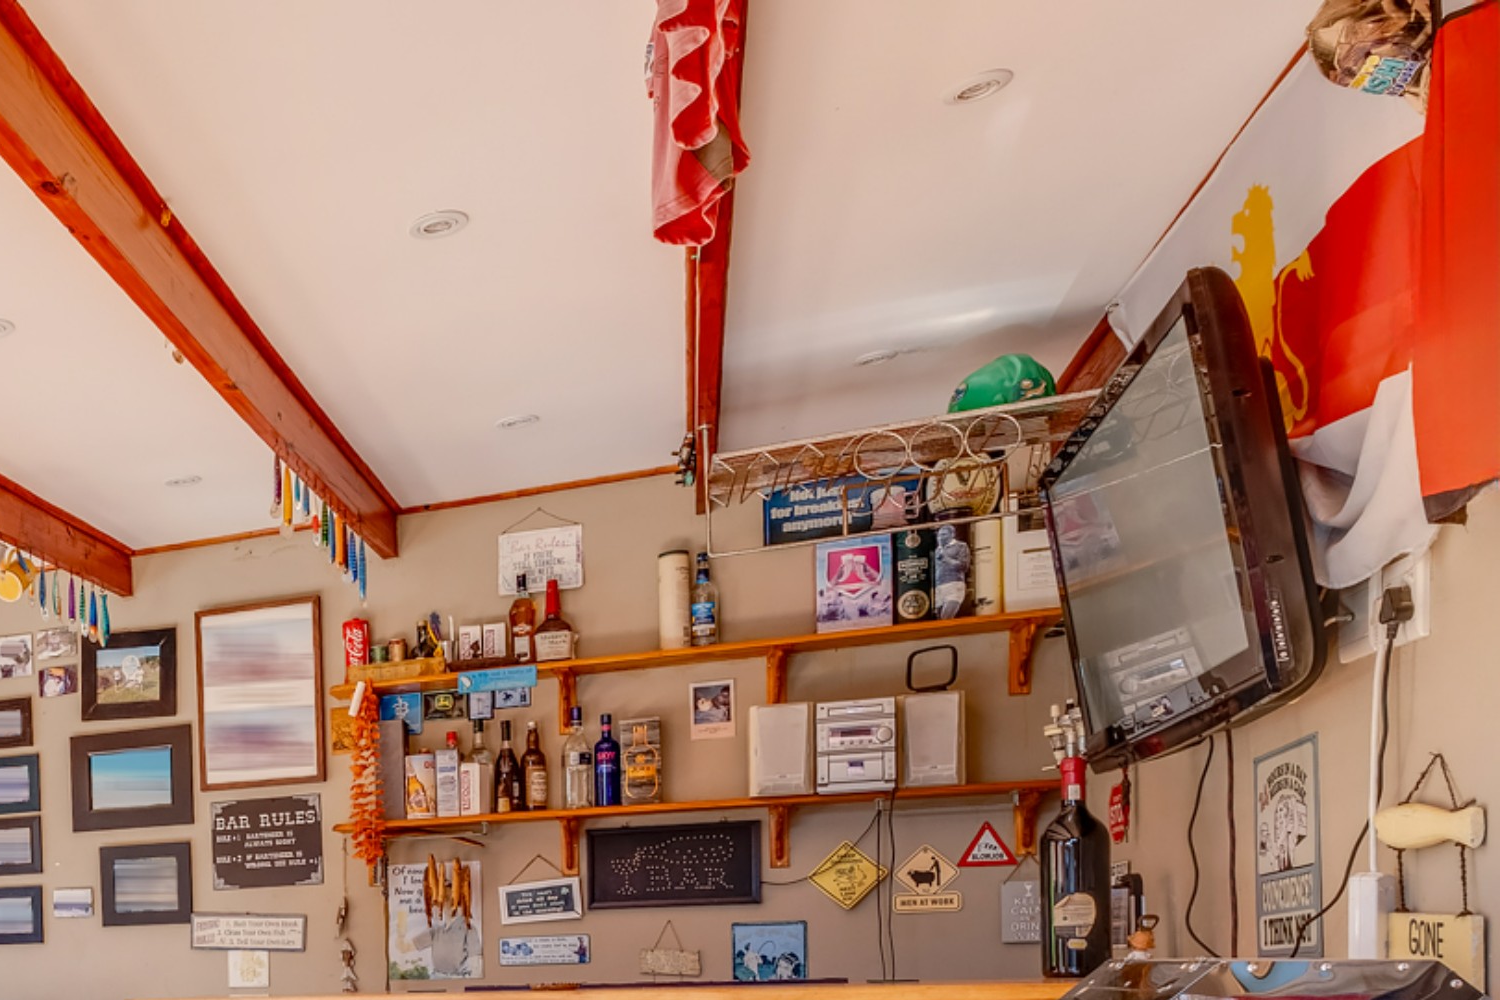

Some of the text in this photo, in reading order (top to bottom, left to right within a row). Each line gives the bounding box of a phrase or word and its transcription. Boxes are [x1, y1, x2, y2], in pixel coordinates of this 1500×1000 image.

[770, 505, 793, 519] for
[216, 809, 316, 830] BAR RULES
[901, 897, 954, 906] MEN AT WORK
[1014, 897, 1041, 905] KEE
[1011, 922, 1040, 931] DRIN
[1409, 918, 1444, 958] GONE
